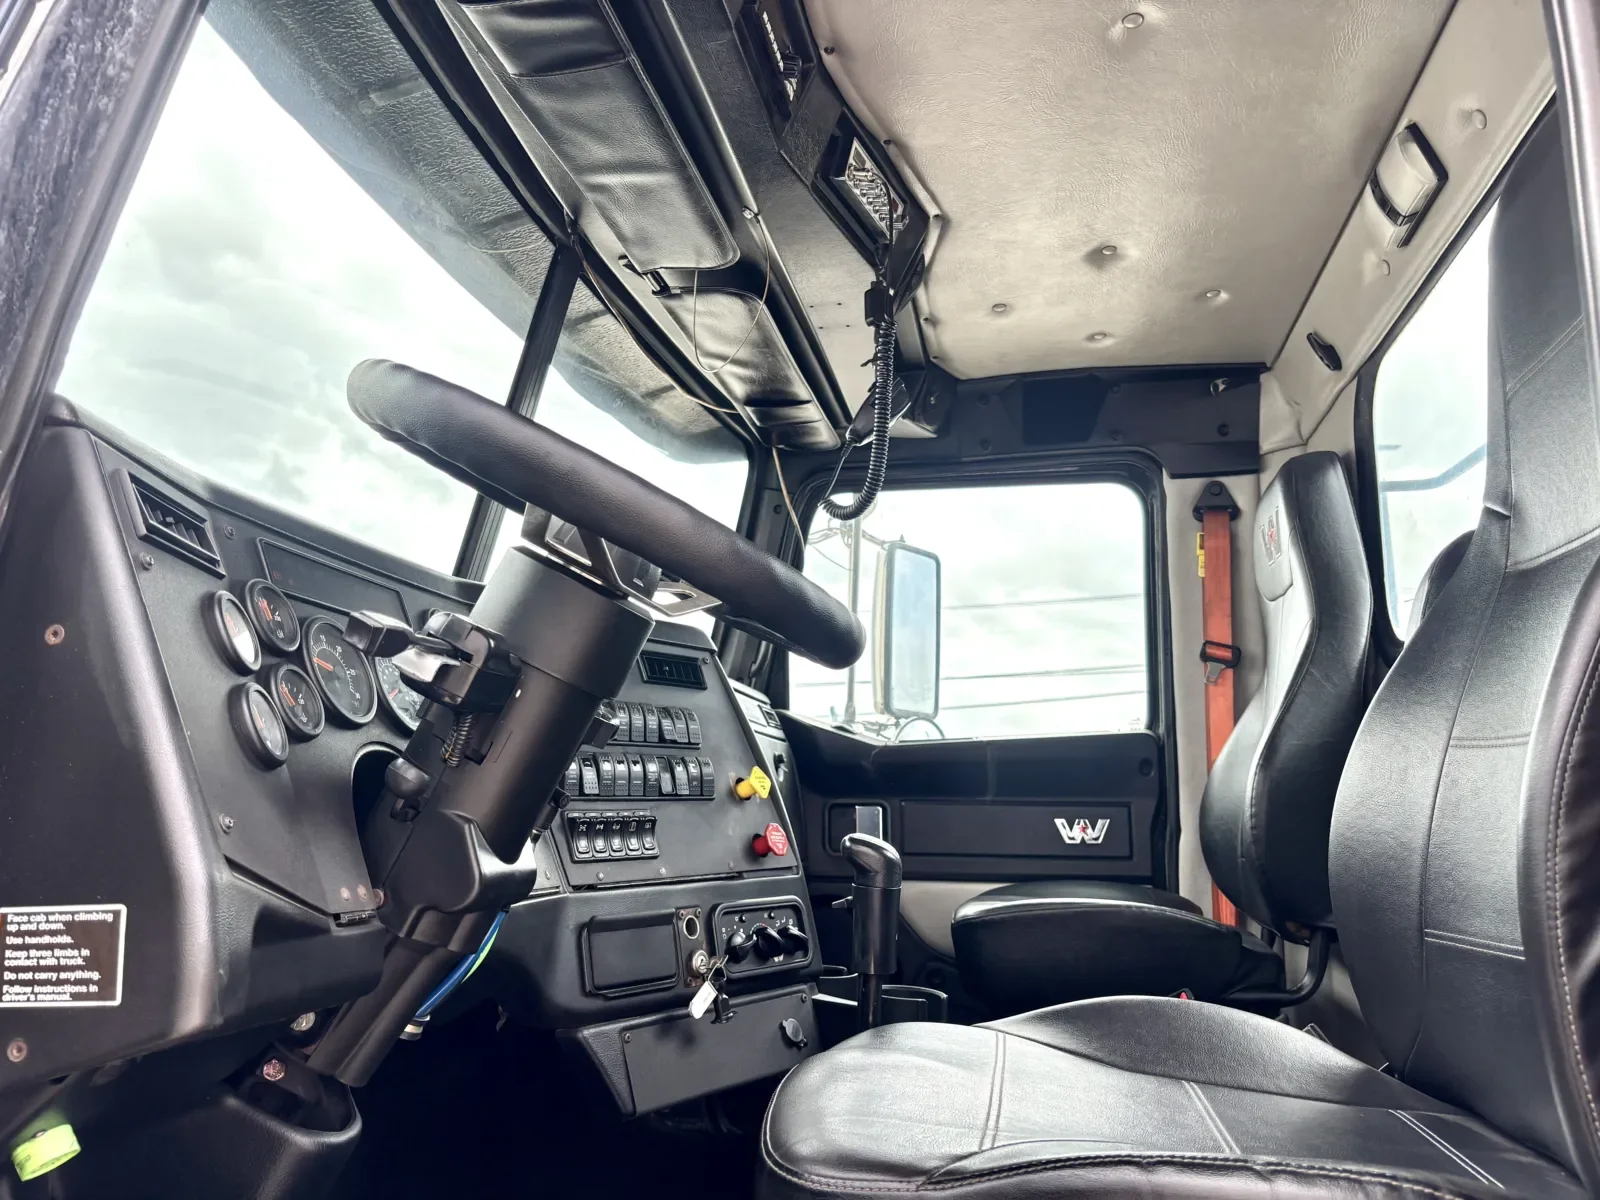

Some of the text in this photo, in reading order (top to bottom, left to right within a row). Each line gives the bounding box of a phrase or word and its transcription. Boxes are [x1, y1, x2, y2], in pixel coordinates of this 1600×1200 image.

[8, 913, 113, 923] Face cab when climbing
[6, 922, 66, 932] up and down.
[6, 935, 74, 945] Use handholds.
[4, 948, 90, 959] Keep three limbs in
[4, 958, 85, 967] contact with truck.
[4, 971, 101, 981] Do not carry anything.
[2, 984, 98, 994] Follow instructions in
[2, 993, 72, 1002] driver's manual.
